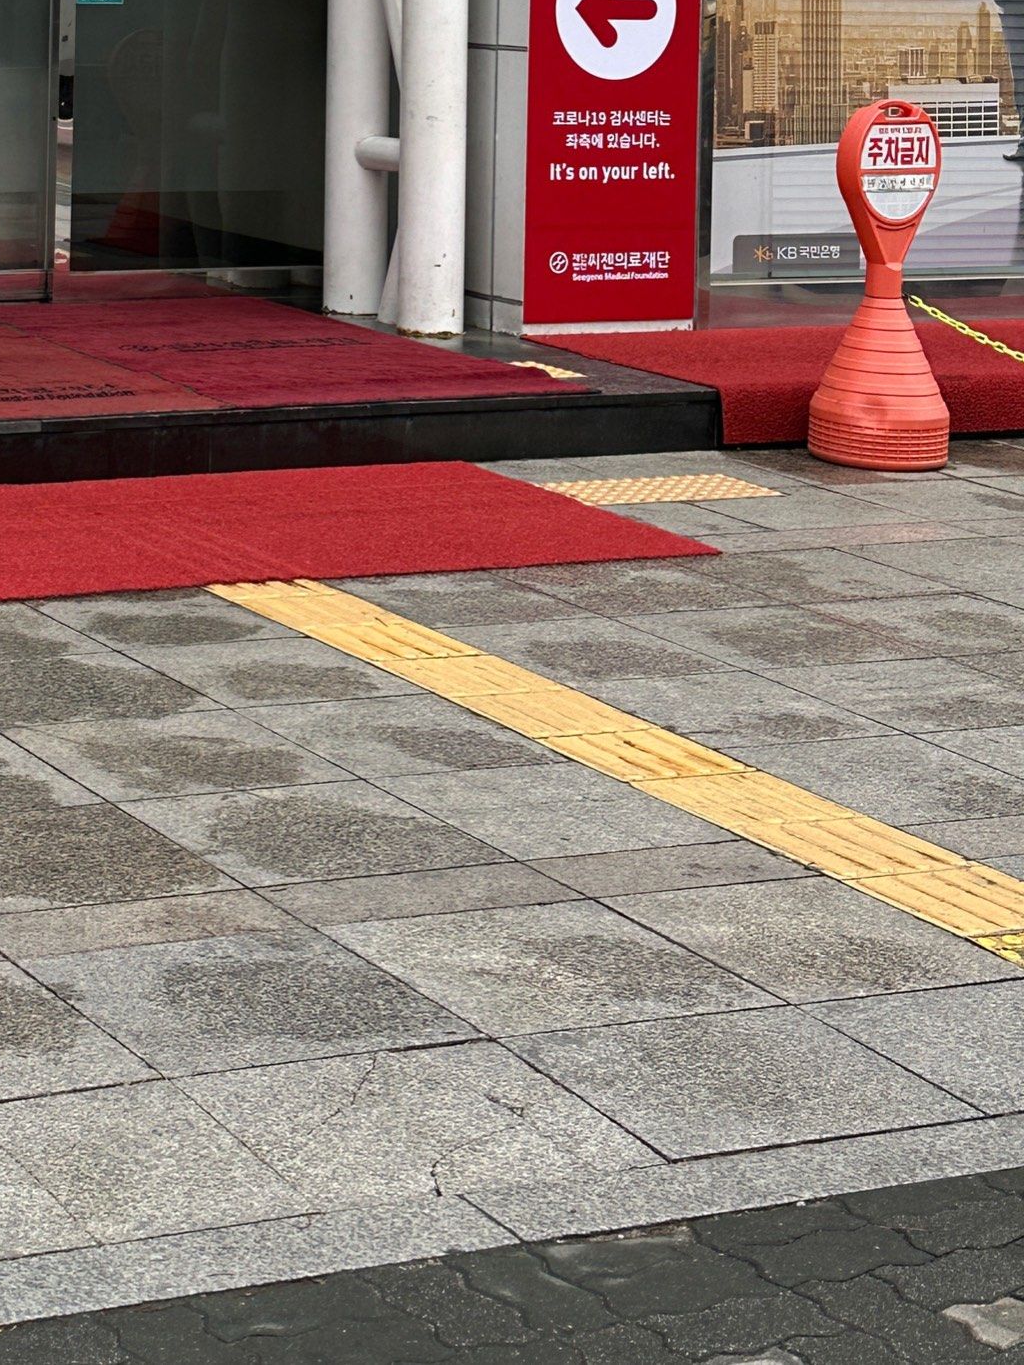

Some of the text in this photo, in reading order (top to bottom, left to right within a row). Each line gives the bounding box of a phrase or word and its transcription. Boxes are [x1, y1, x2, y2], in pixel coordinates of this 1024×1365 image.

[552, 110, 671, 126] 코로나19 검사센터는
[565, 133, 660, 149] 좌측에 있습니다.
[868, 136, 930, 166] 주차금지
[579, 166, 598, 180] on
[602, 166, 639, 184] your
[642, 162, 676, 180] left.
[777, 246, 798, 260] KB
